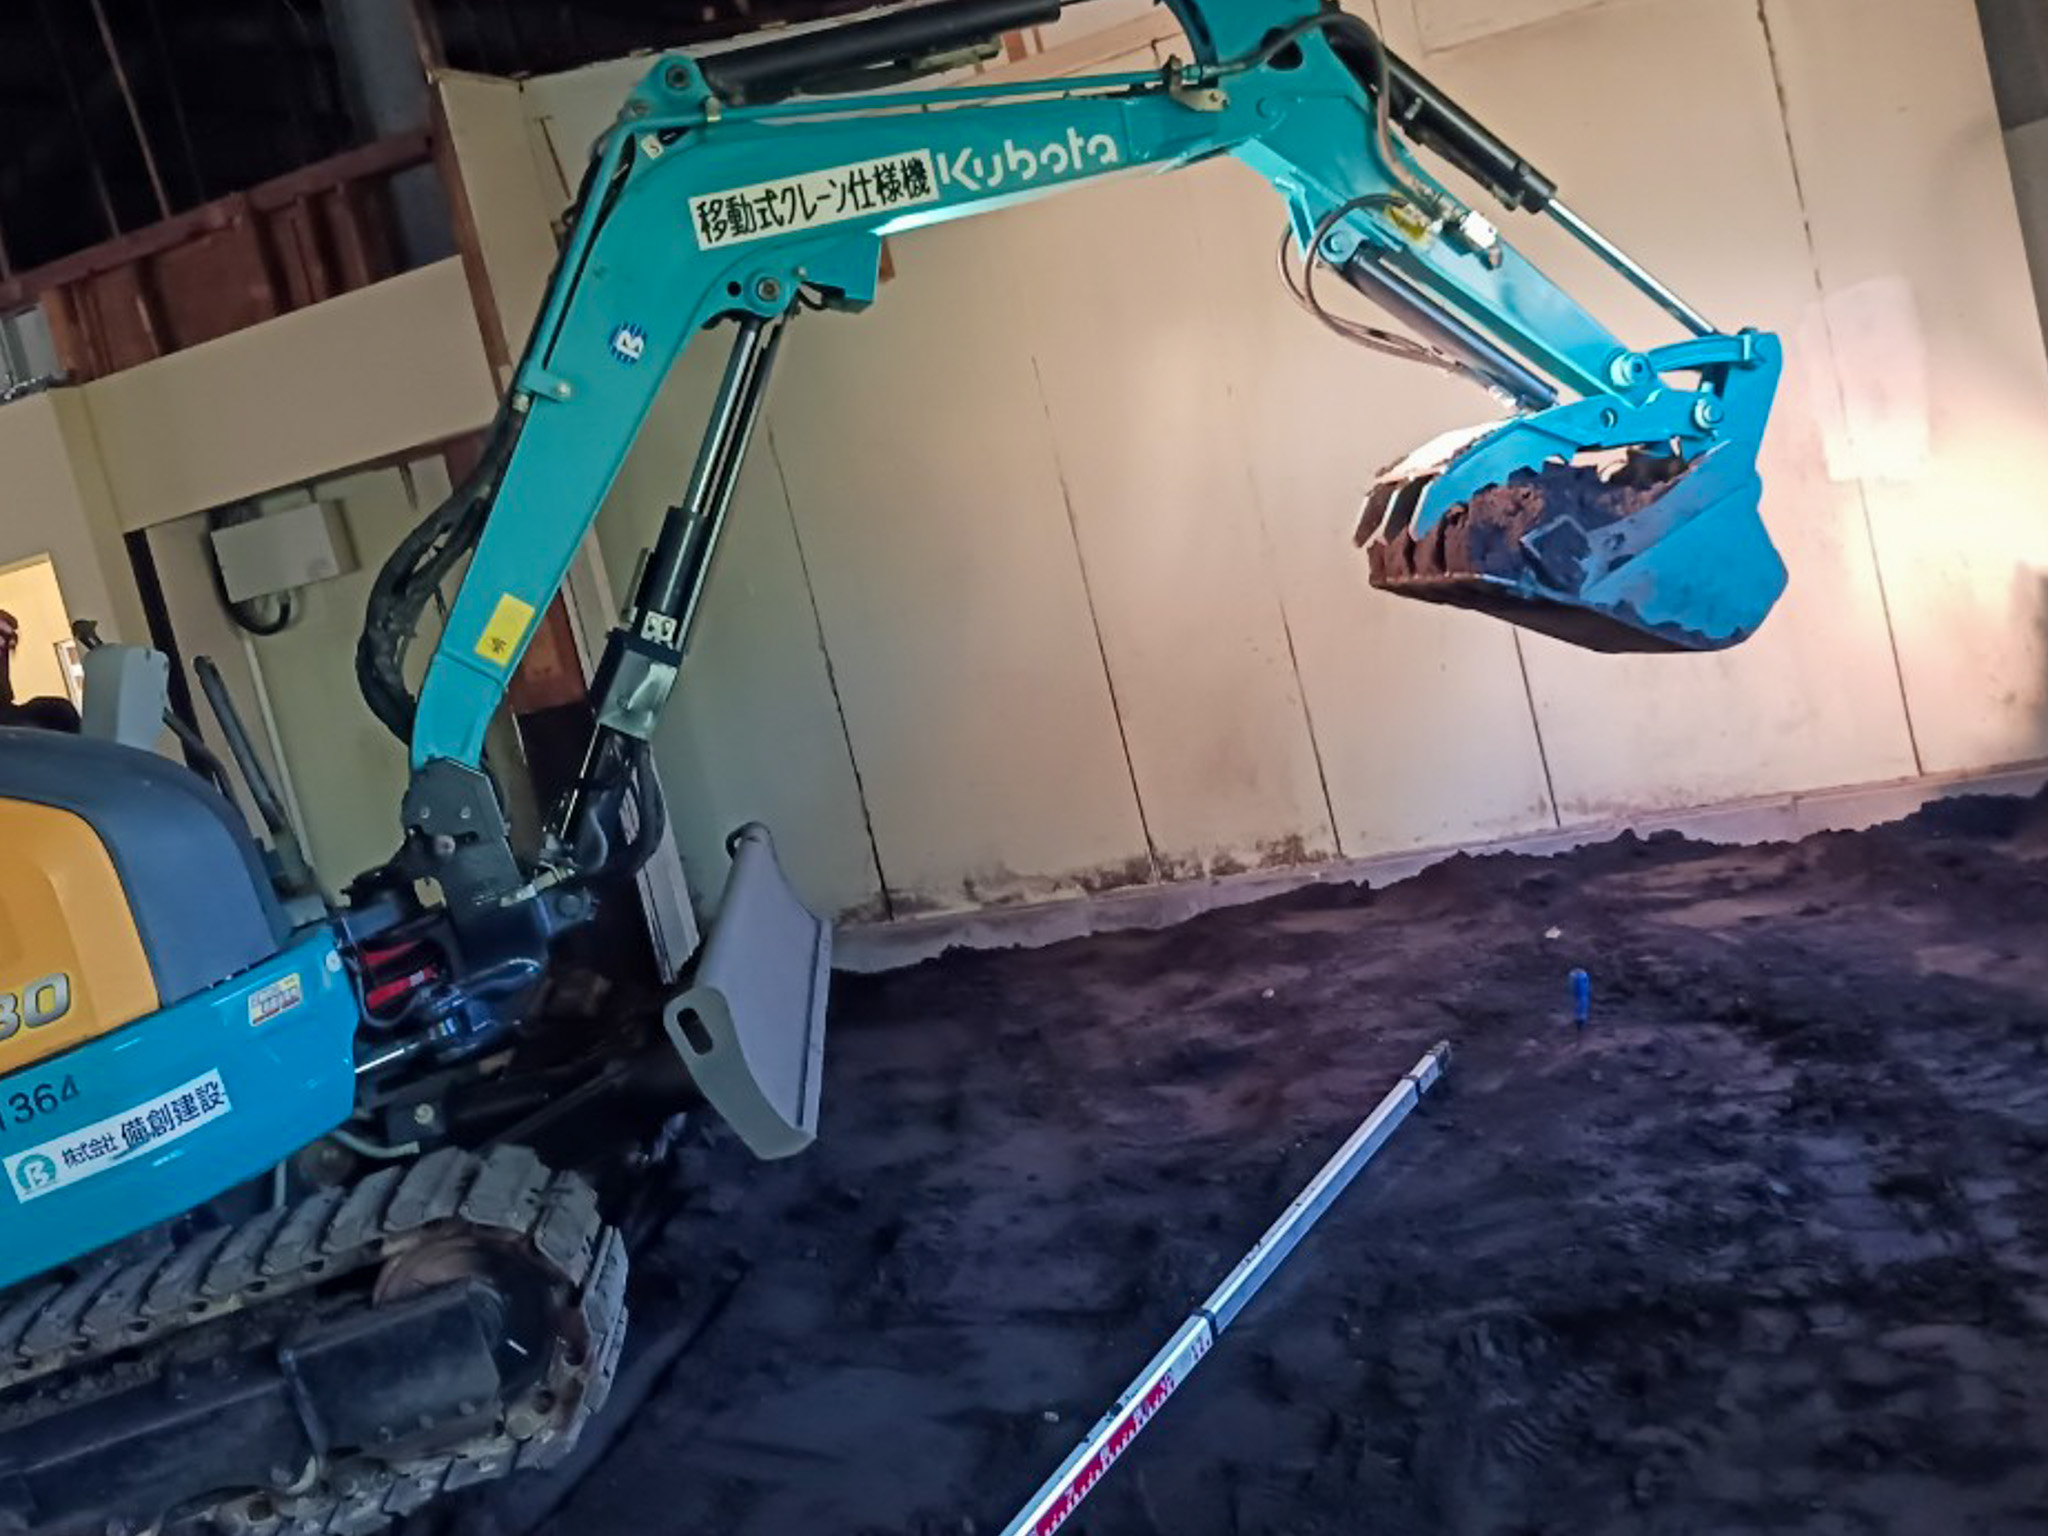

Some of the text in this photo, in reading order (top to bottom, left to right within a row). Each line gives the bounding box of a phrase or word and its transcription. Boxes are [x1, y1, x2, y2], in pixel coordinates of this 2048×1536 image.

[936, 126, 1120, 191] Kubota
[696, 156, 931, 244] 移動式クレーン仕様機
